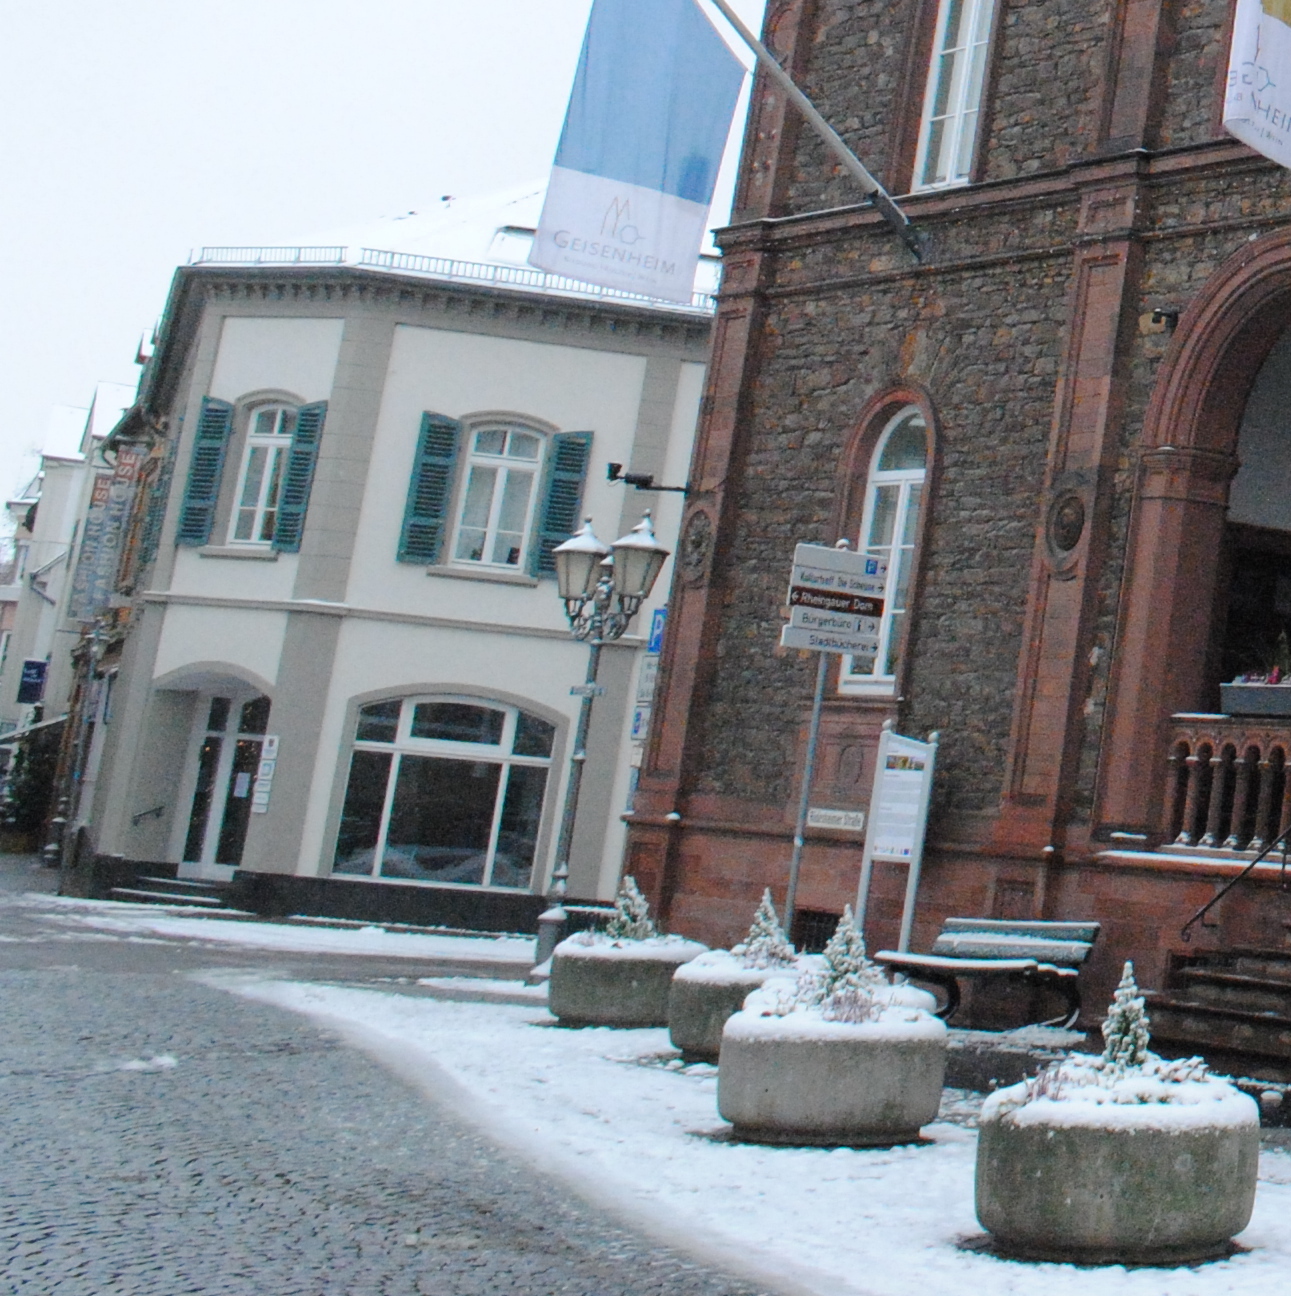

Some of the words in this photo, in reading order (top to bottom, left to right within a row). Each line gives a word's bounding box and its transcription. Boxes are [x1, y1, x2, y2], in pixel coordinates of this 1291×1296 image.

[553, 229, 676, 275] GEISENHEIM
[109, 453, 136, 517] HOUSE
[801, 592, 851, 609] Rheingauer
[853, 598, 873, 611] Dom
[802, 612, 852, 628] Bürgerbüro
[809, 634, 870, 652] Stadtbücherei
